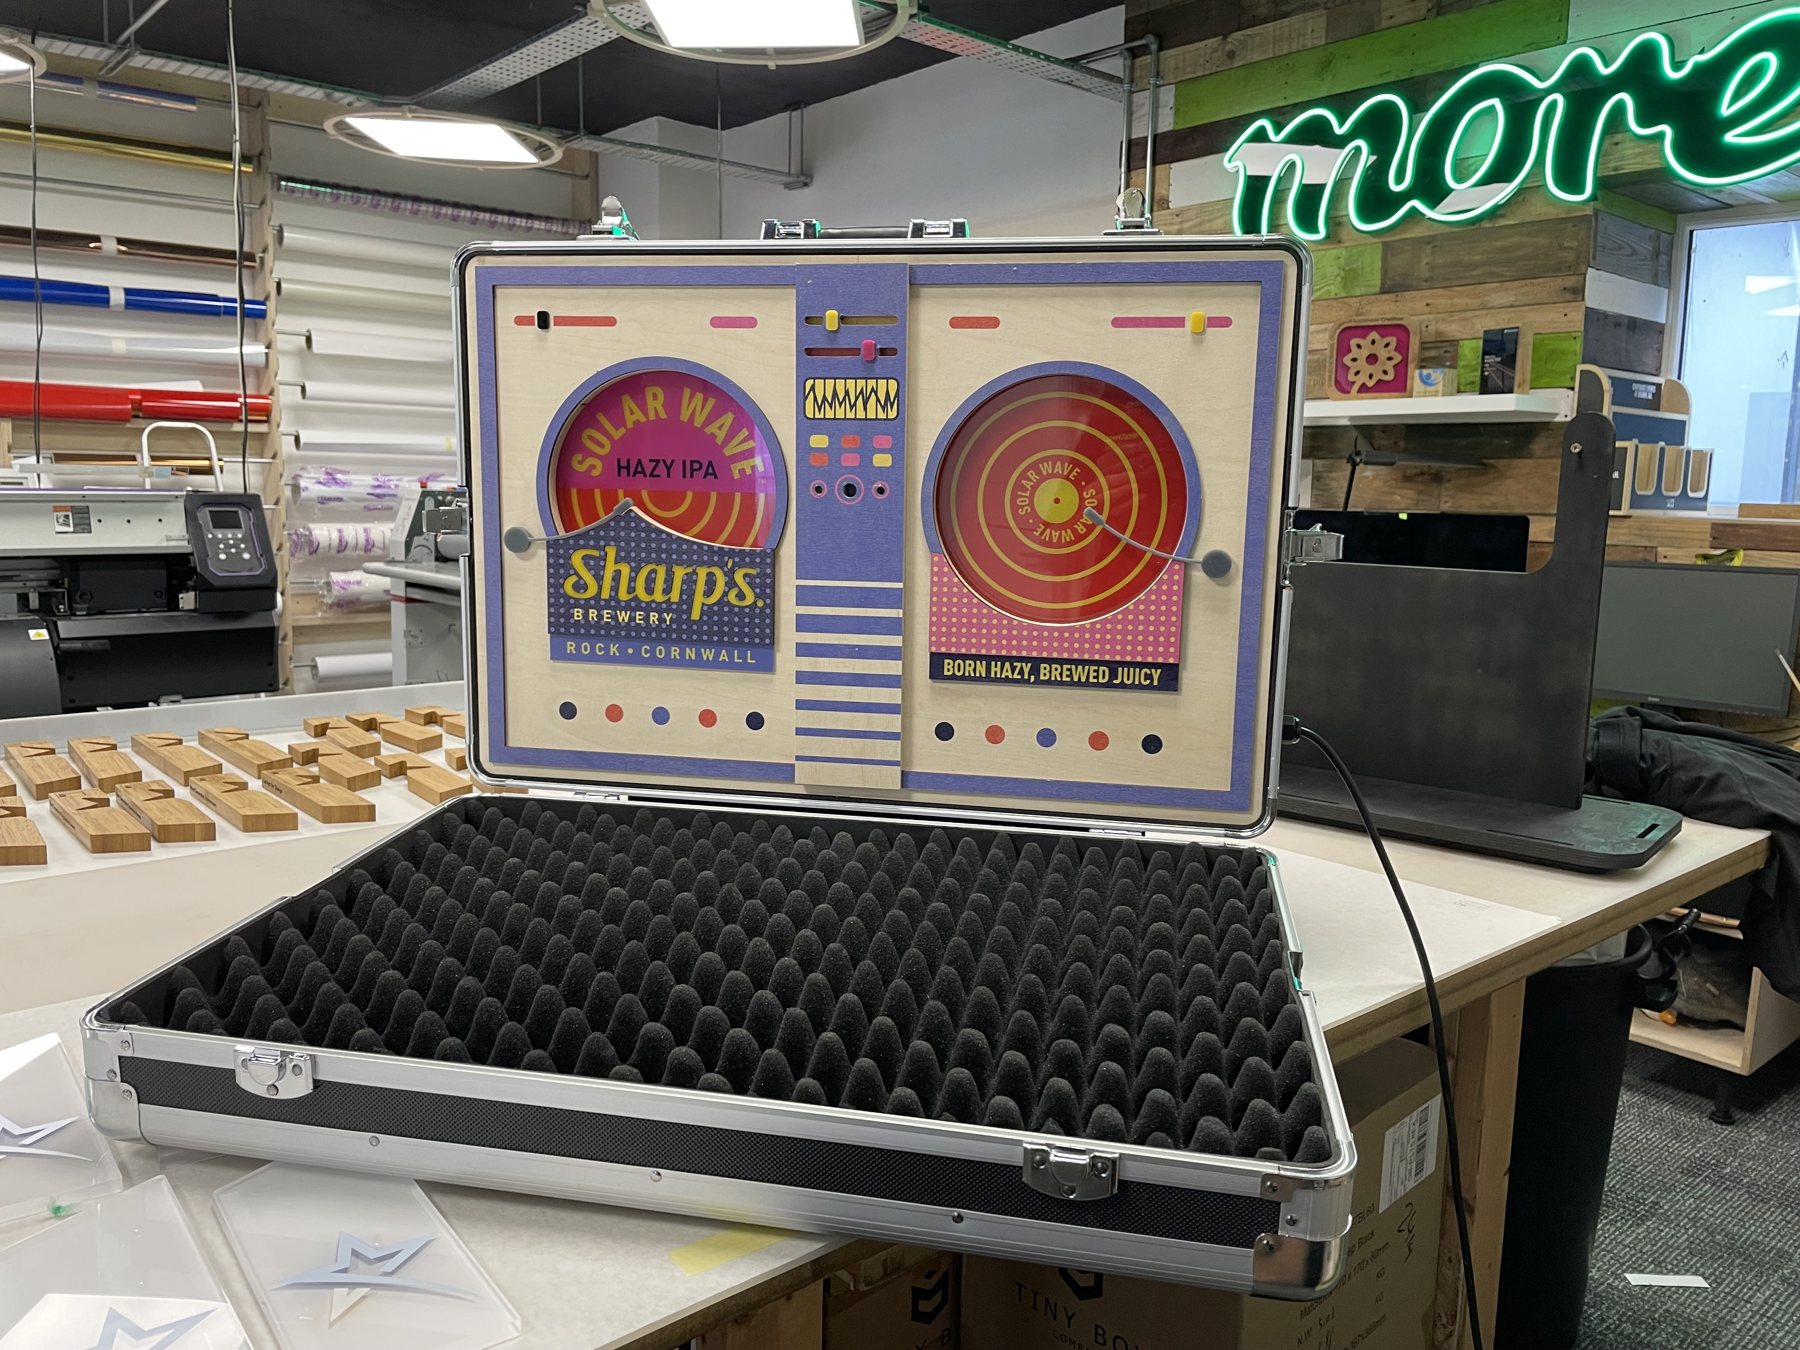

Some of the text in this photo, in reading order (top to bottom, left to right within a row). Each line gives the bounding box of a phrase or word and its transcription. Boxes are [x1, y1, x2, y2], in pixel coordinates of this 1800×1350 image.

[1223, 5, 1800, 241] more
[571, 386, 765, 480] SOLAR WAVE
[616, 457, 719, 480] HAZY IPA
[1017, 460, 1082, 516] SOLAR WAVE
[1032, 487, 1098, 544] SOAR WAVE
[573, 608, 674, 625] BREWERY
[566, 640, 756, 664] ROCK CORNWALL
[943, 658, 1163, 686] BORN HAZY, BREWED JUICY
[1013, 1279, 1140, 1350] TINY BO
